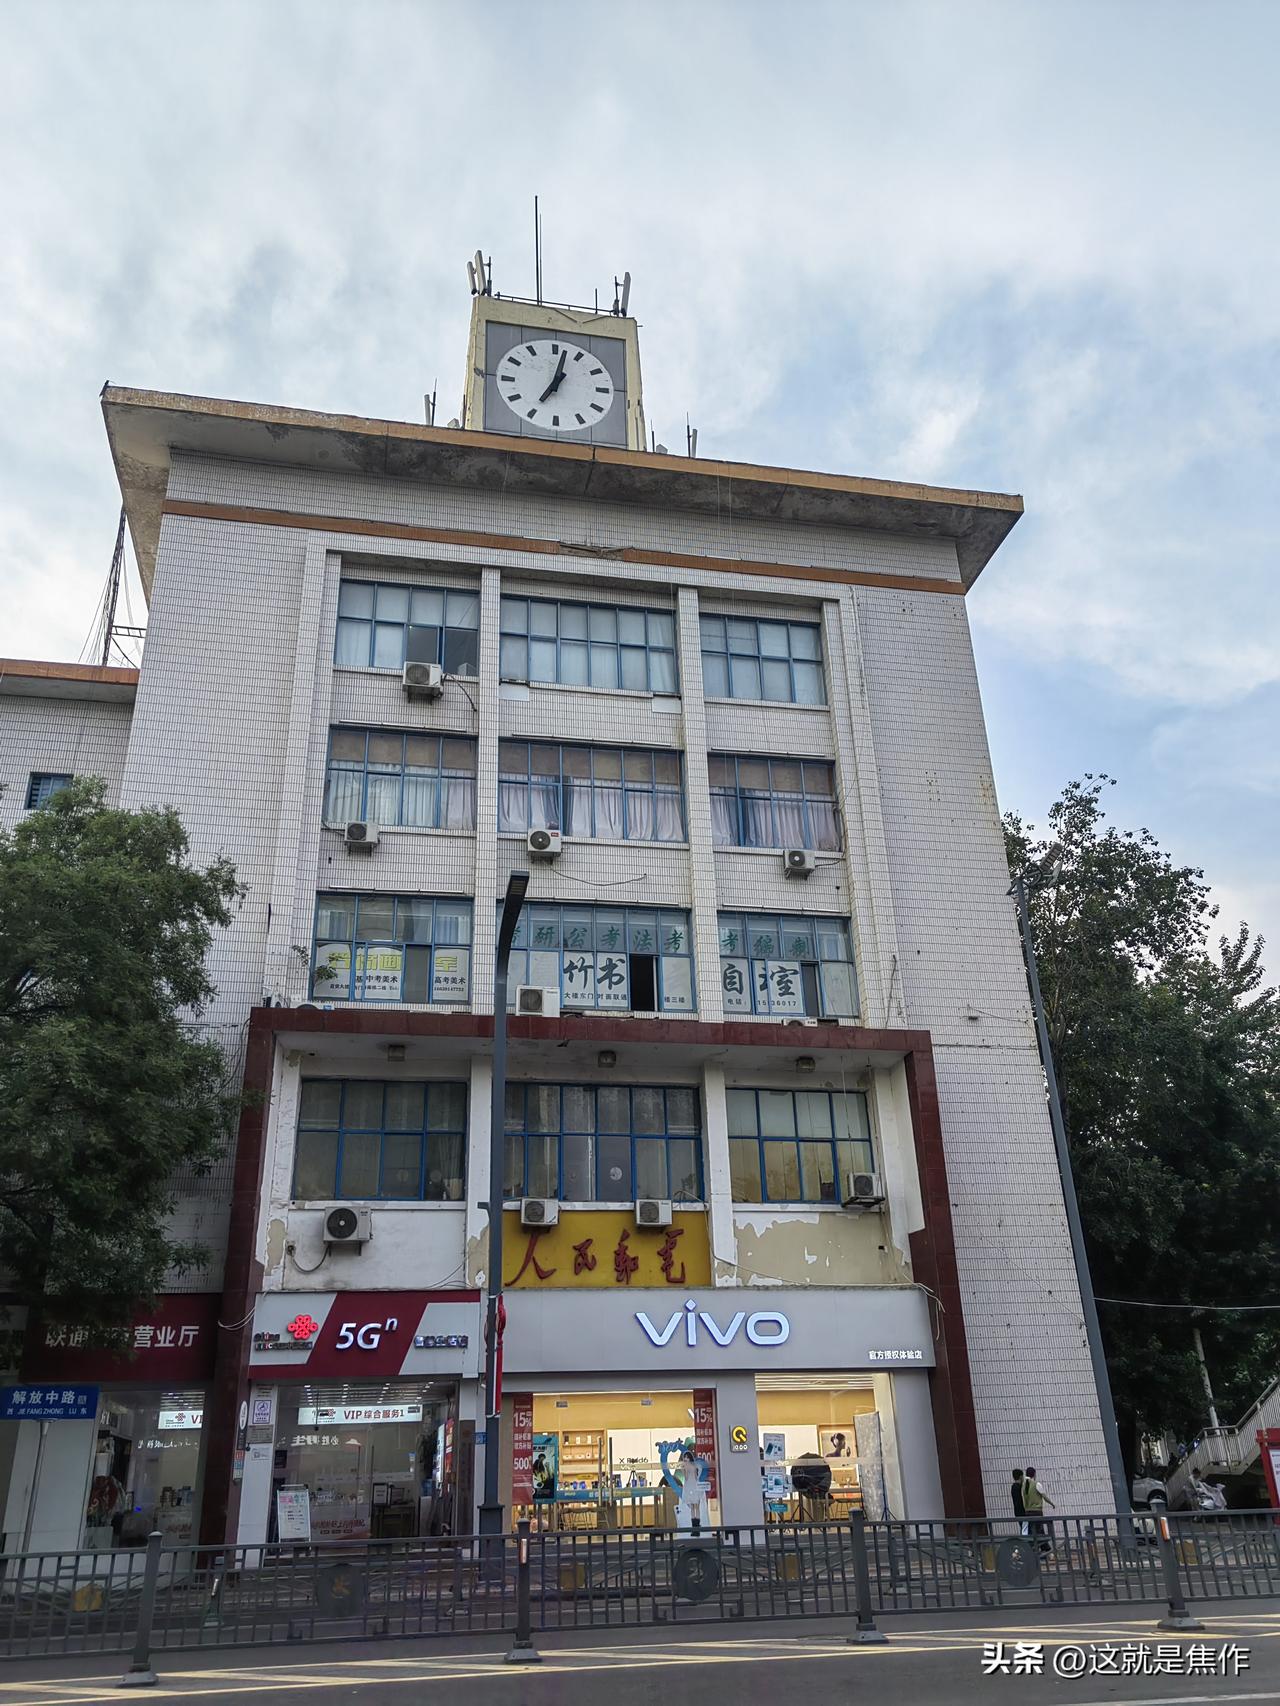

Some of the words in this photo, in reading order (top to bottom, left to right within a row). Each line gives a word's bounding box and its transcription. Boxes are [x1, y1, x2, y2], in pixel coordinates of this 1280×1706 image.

[635, 1299, 790, 1347] vivo
[12, 1390, 76, 1405] 解放中路
[344, 1410, 362, 1420] VIP
